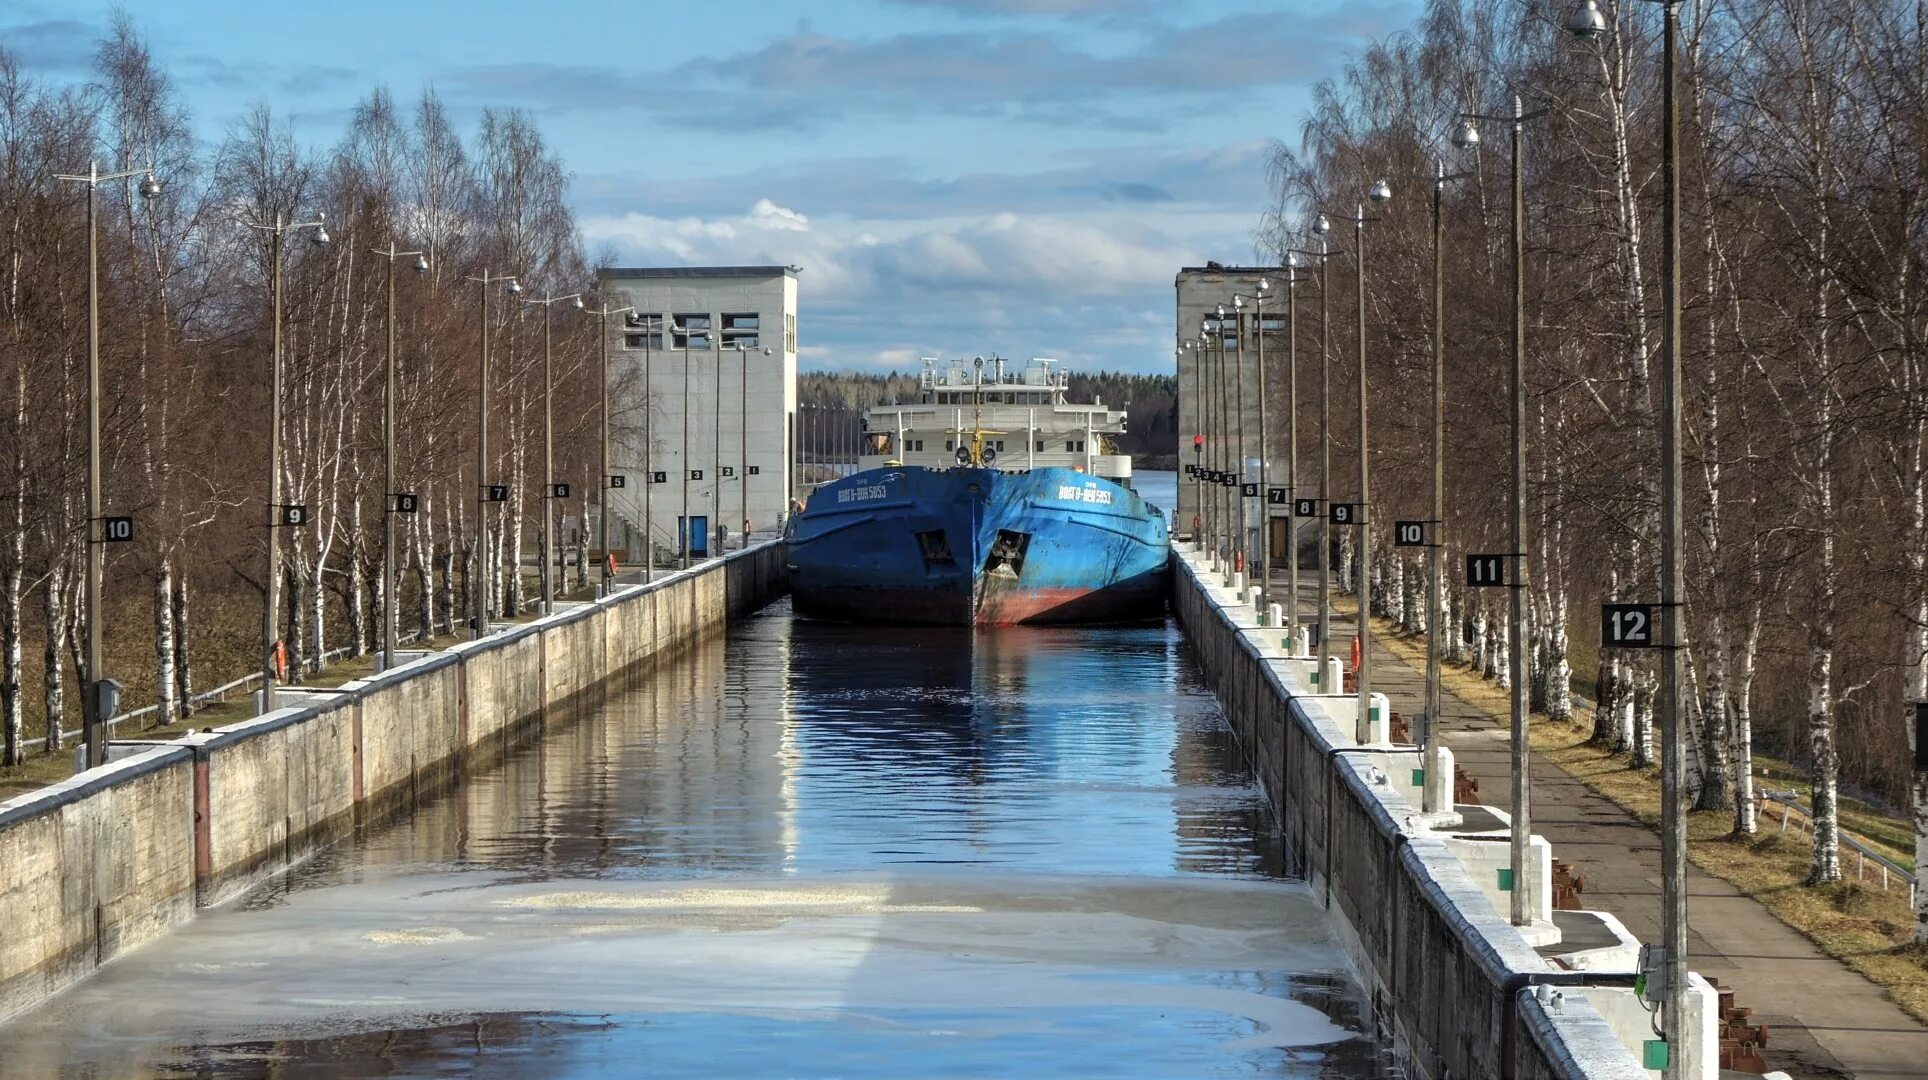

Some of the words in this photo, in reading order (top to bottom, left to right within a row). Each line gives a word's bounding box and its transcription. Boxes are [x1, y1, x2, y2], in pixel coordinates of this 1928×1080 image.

[694, 471, 700, 479] 3
[725, 467, 731, 475] 2
[614, 477, 622, 487] 5
[657, 473, 664, 482] 4
[1213, 473, 1220, 482] 4
[1226, 475, 1234, 485] 5
[494, 488, 503, 499] 7
[557, 486, 566, 496] 6
[869, 486, 886, 499] 5053
[1246, 485, 1254, 495] 6
[1272, 490, 1281, 502] 7
[1096, 490, 1111, 504] 5053
[402, 497, 412, 510] 8
[1301, 501, 1310, 514] 8
[289, 508, 301, 523] 9
[1336, 507, 1347, 521] 9
[109, 520, 129, 538] 10
[1401, 524, 1420, 542] 10
[1474, 559, 1496, 582] 11
[1611, 611, 1645, 640] 12
